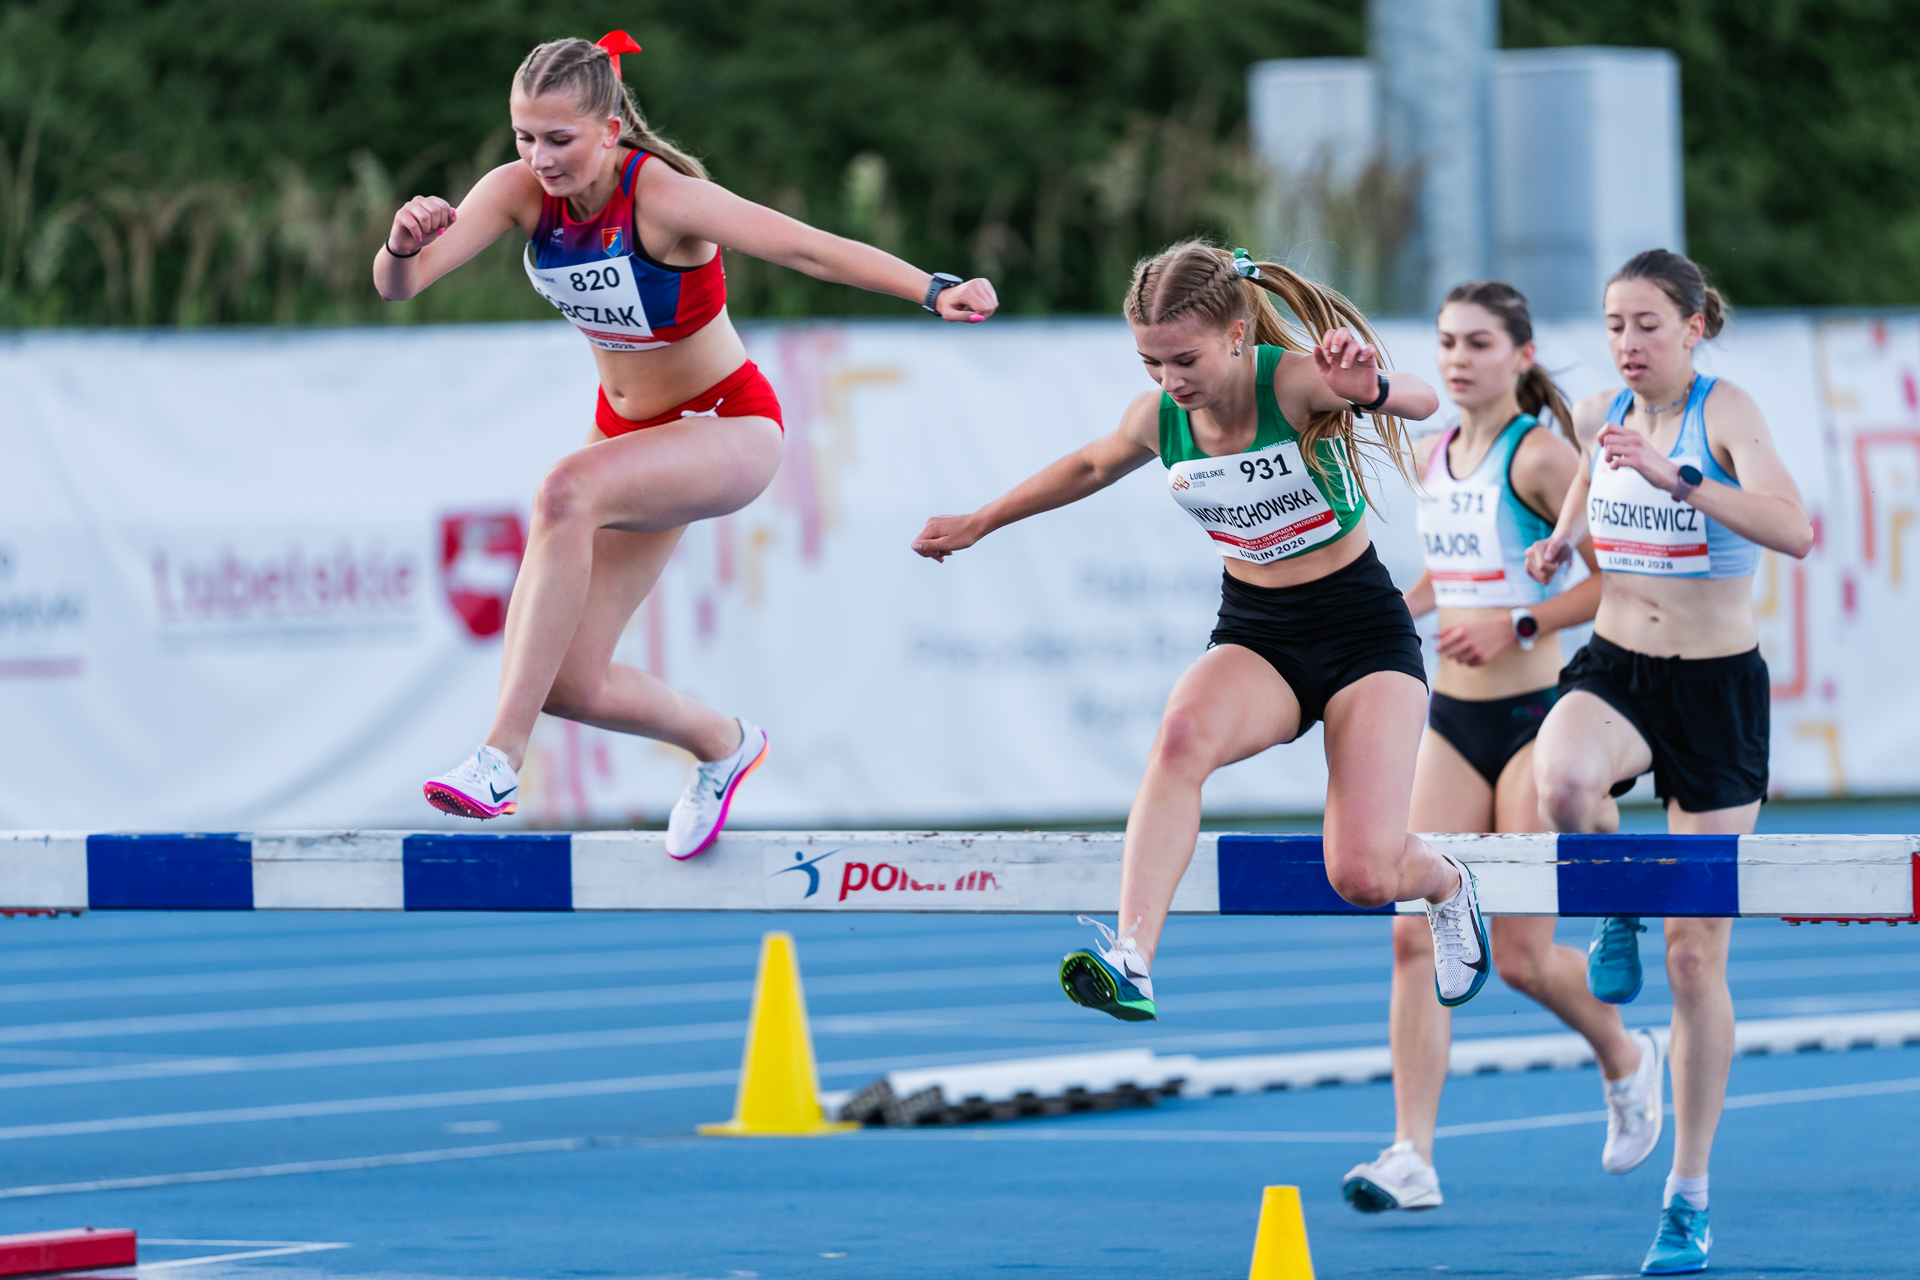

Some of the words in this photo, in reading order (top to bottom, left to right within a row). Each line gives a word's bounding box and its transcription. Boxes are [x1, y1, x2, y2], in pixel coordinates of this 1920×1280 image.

[569, 266, 620, 292] 820
[1189, 468, 1226, 481] LUBELSKIE
[1239, 453, 1292, 483] 931
[1188, 488, 1318, 529] WOJCIECHOWSKA
[1451, 492, 1484, 514] 571
[1591, 498, 1698, 532] STASZKIEWICZ
[1239, 549, 1275, 561] LUBLIN
[1275, 537, 1306, 555] 2026
[1608, 555, 1645, 567] LUBLIN
[1647, 559, 1674, 570] 2026
